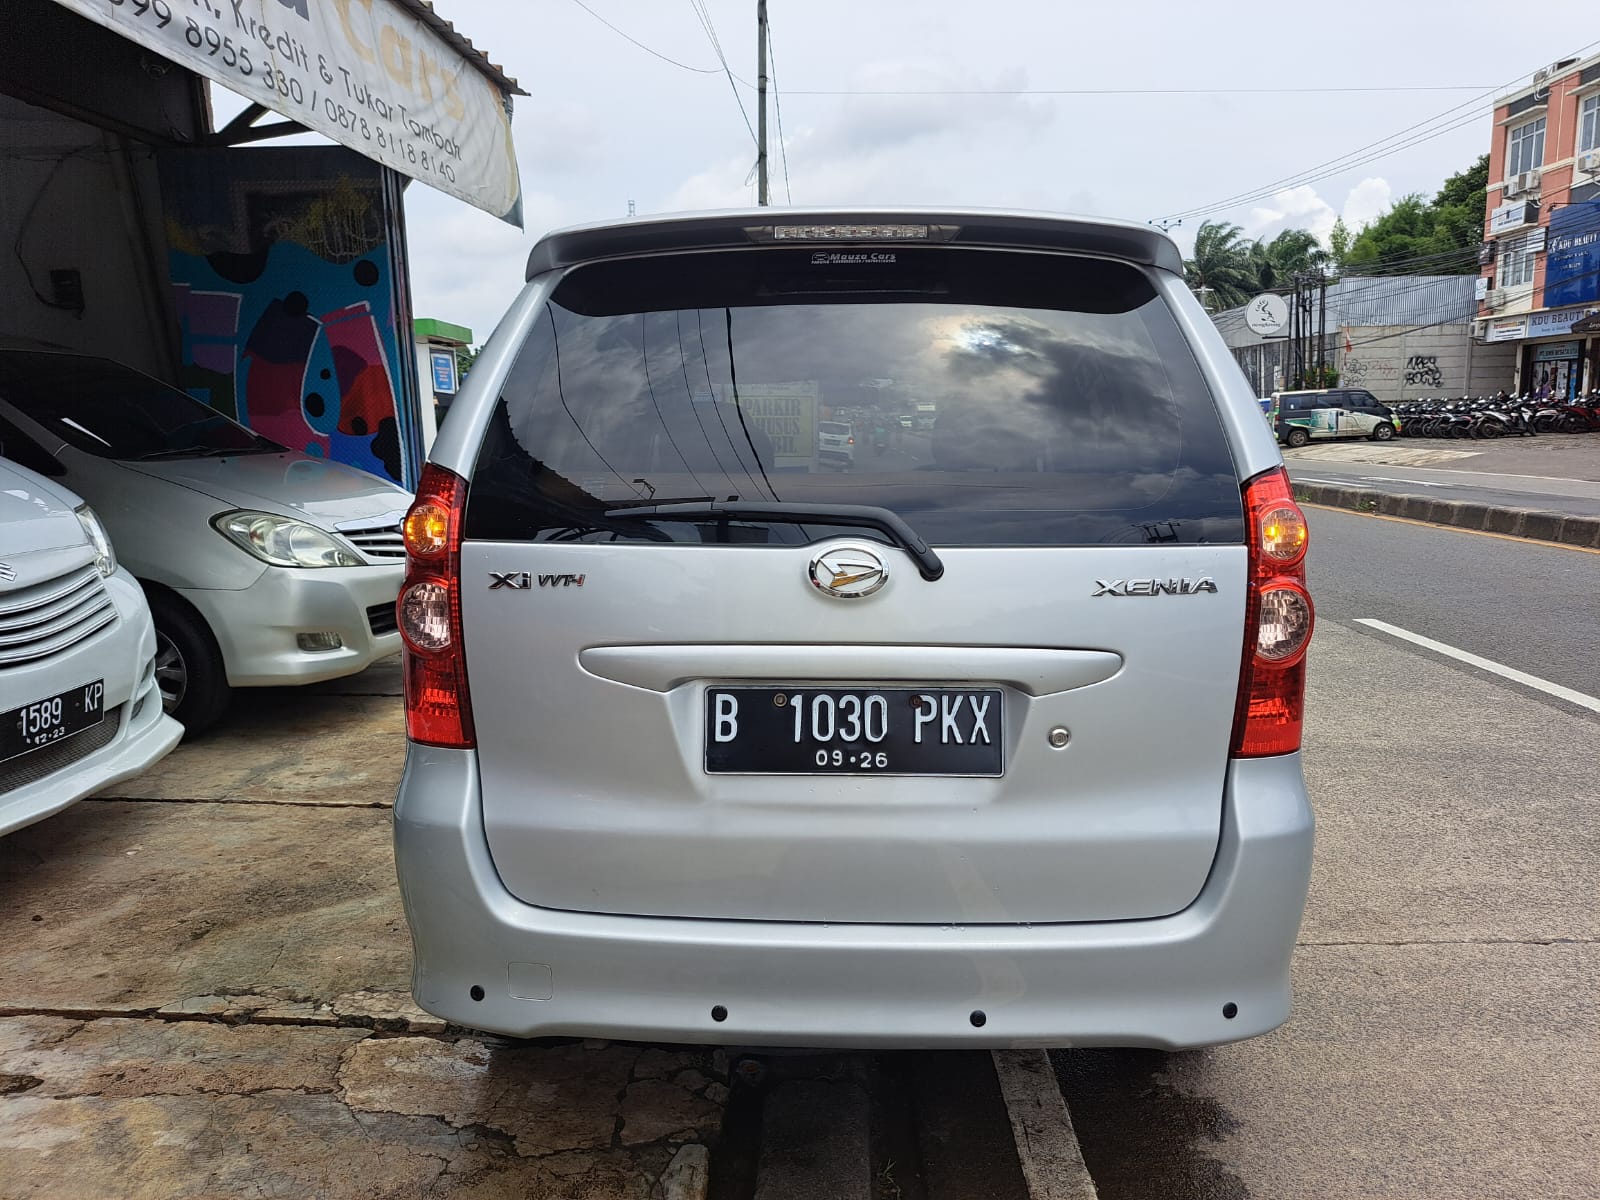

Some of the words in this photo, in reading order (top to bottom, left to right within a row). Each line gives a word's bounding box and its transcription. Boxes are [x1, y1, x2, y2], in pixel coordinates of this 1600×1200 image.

[185, 16, 254, 76] 8955
[263, 61, 304, 105] 330
[311, 90, 317, 112] /
[325, 98, 371, 140] 0878
[377, 127, 416, 164] 8118
[421, 157, 456, 183] 8140
[231, 0, 309, 73] Kredit
[318, 54, 334, 85] &
[339, 66, 394, 123] Tukar
[398, 104, 462, 161] Tambah
[870, 252, 896, 260] Cars
[1531, 315, 1549, 326] KDU
[1091, 576, 1218, 597] XENIA
[20, 697, 62, 736] 1589
[84, 683, 103, 713] KP
[714, 693, 739, 743] B
[790, 693, 888, 744] 1030
[912, 694, 992, 744] PKX
